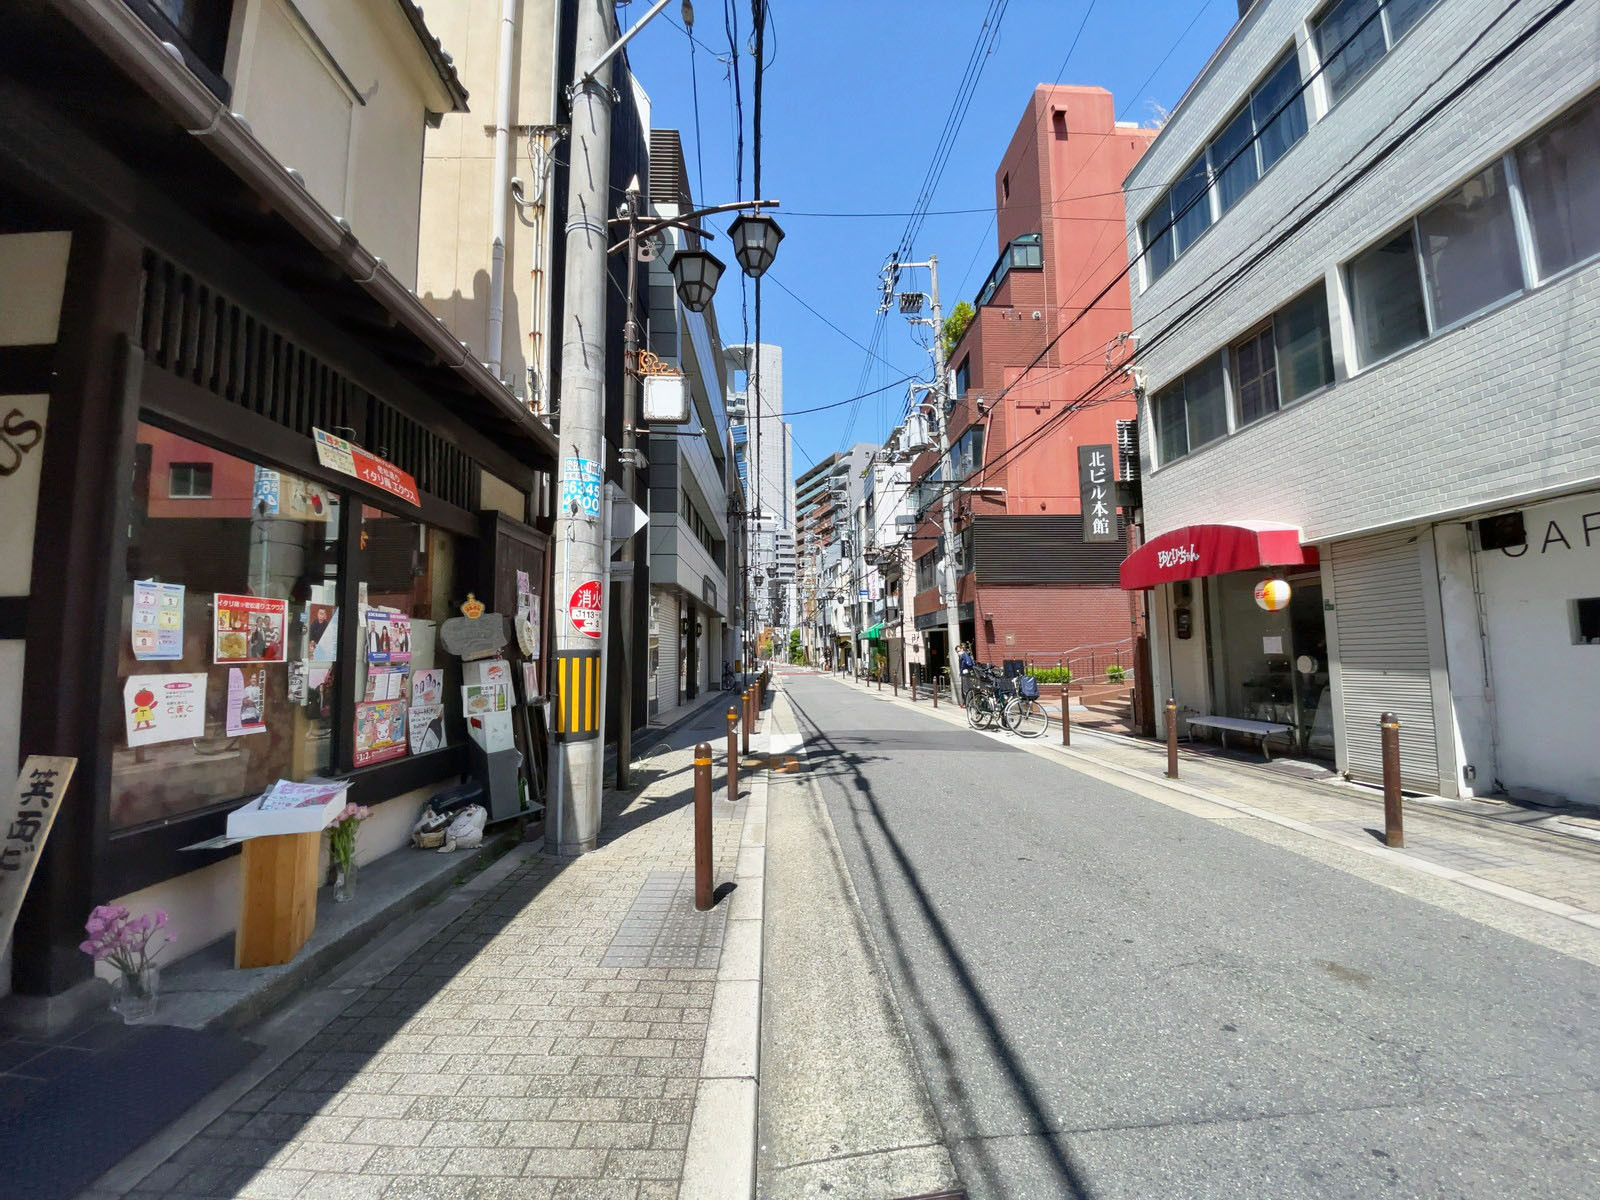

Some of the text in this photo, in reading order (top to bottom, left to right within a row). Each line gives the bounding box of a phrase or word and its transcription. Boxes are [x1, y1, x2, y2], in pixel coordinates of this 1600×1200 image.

[569, 481, 600, 498] 6345
[1088, 451, 1109, 535] 北ビル本館
